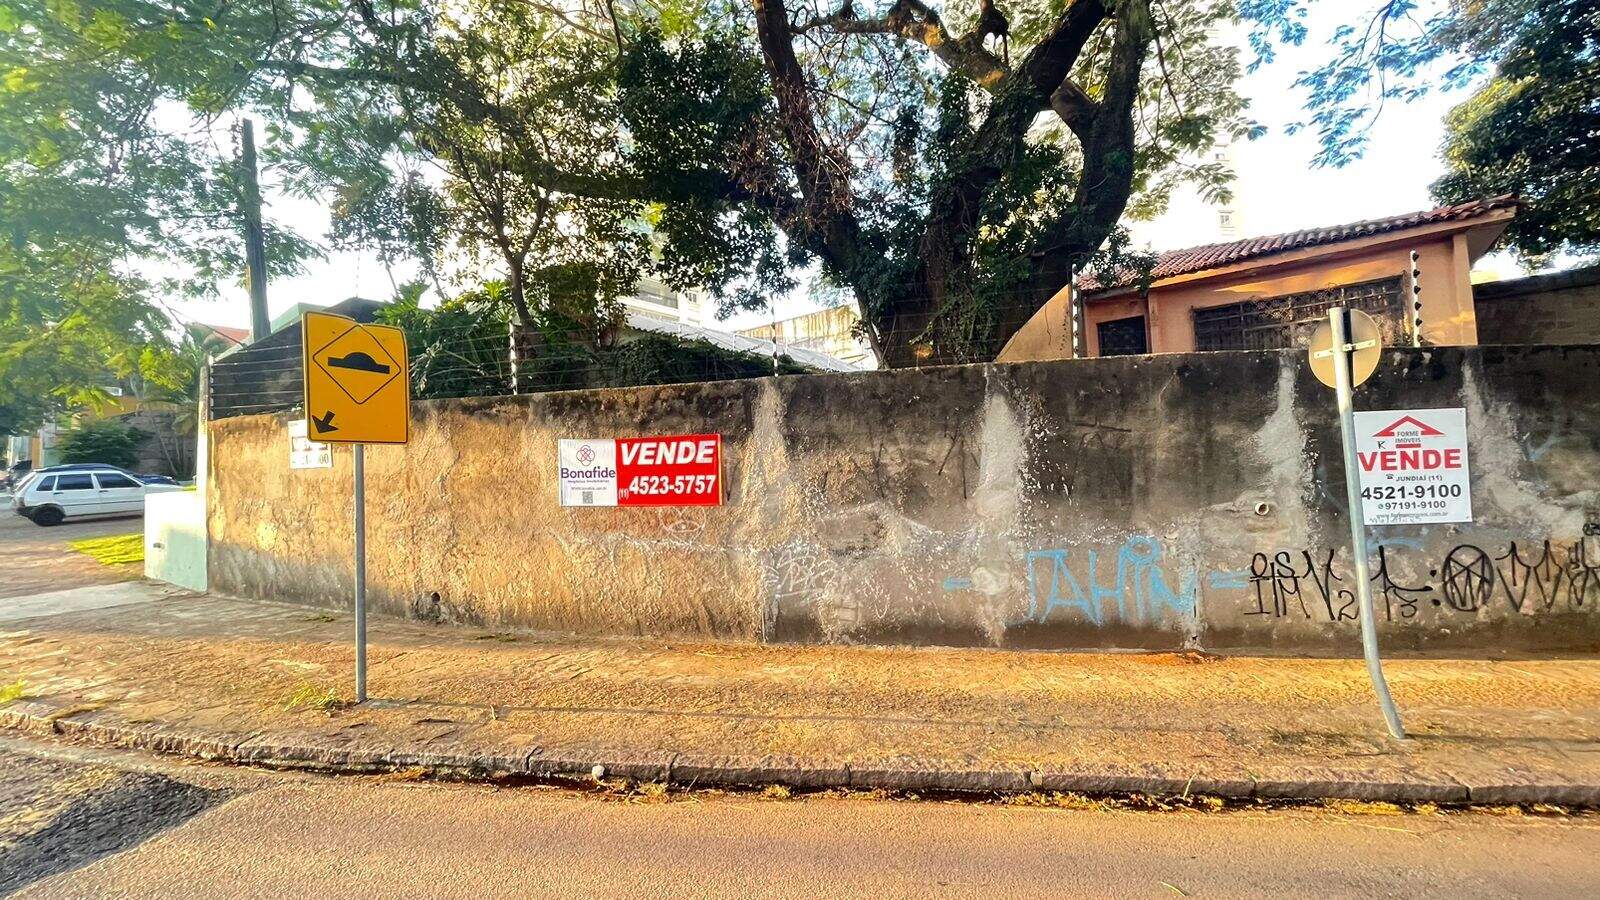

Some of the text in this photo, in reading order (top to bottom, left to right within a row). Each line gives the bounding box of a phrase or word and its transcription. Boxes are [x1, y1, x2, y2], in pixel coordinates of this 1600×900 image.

[621, 440, 716, 465] VENDE
[1357, 448, 1462, 471] VENDE
[561, 466, 616, 478] Bonafide
[629, 475, 716, 494] 4523-5757
[1361, 484, 1461, 499] 4521-9100
[1385, 501, 1446, 510] 97191-9100
